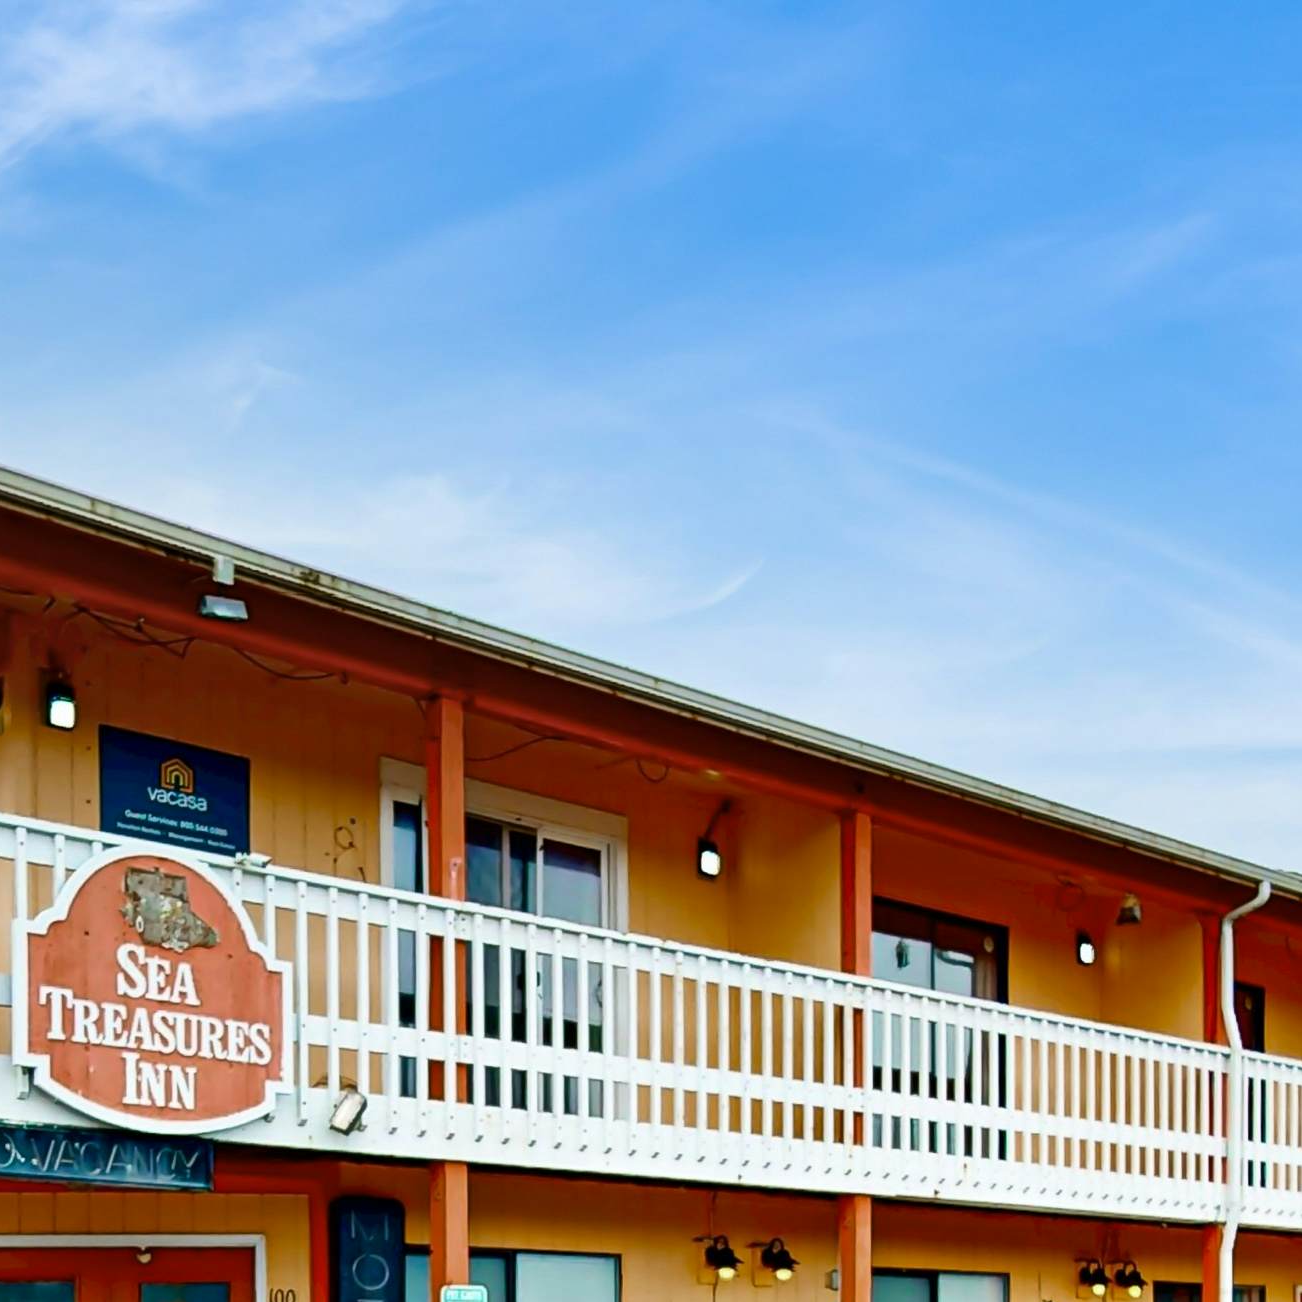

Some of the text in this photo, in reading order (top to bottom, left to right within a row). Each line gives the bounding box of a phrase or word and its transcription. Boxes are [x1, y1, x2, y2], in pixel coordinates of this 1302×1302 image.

[147, 787, 207, 812] vacasa
[117, 943, 201, 1006] SEA
[39, 986, 271, 1066] TREASURES
[121, 1052, 197, 1111] INN
[31, 1137, 199, 1181] VACANCY
